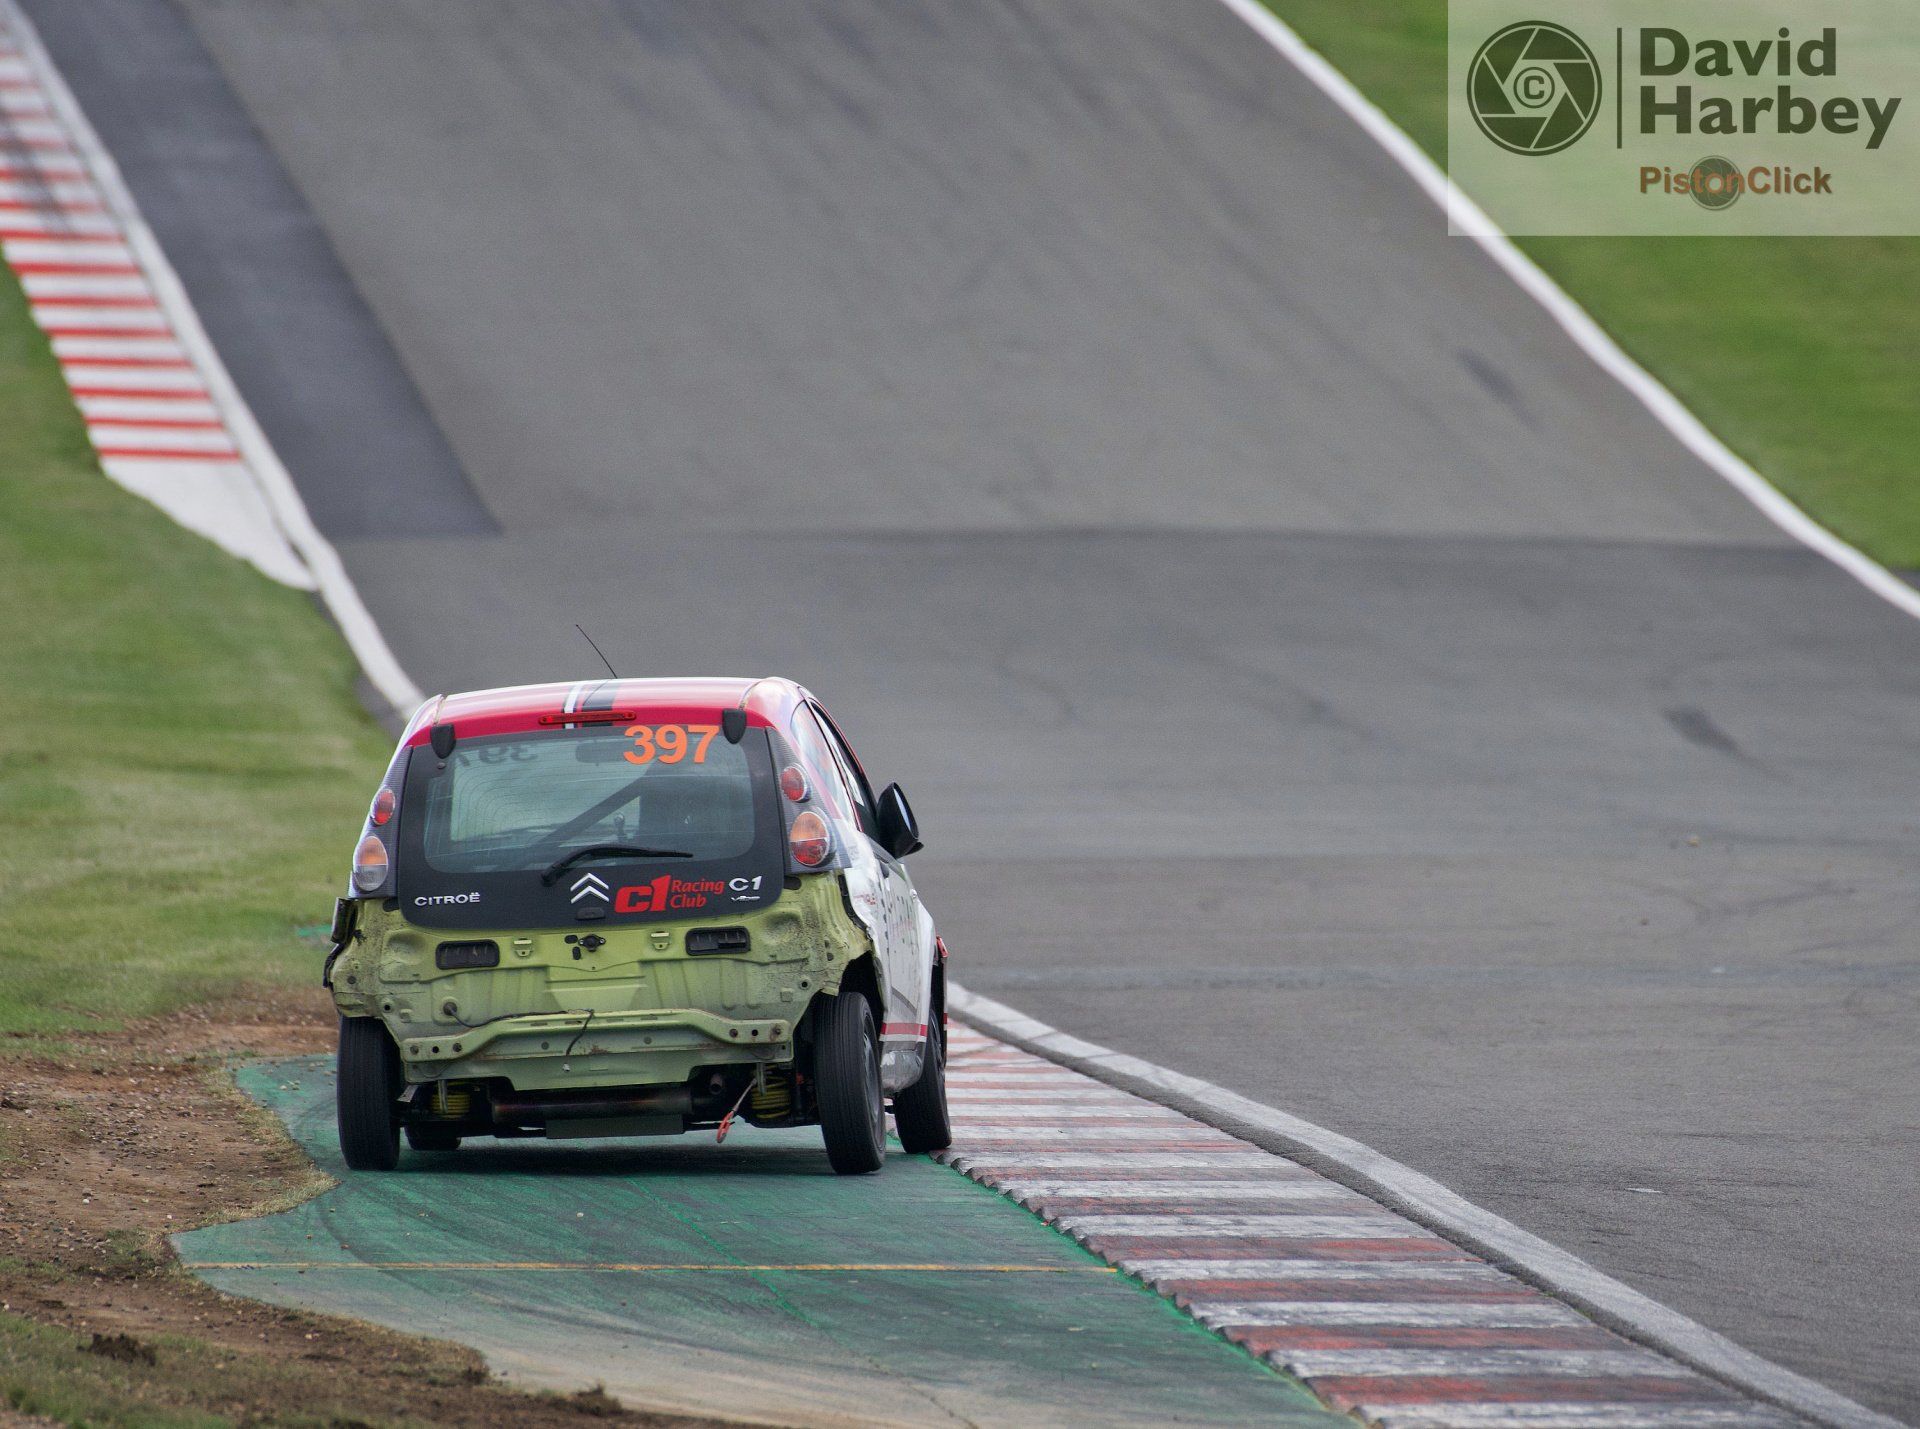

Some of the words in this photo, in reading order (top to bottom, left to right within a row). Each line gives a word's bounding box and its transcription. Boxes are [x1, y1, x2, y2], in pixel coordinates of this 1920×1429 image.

[623, 724, 720, 765] 397
[671, 878, 725, 895] Racing
[729, 875, 763, 891] C1
[414, 891, 481, 907] CITROË
[670, 892, 707, 909] Club
